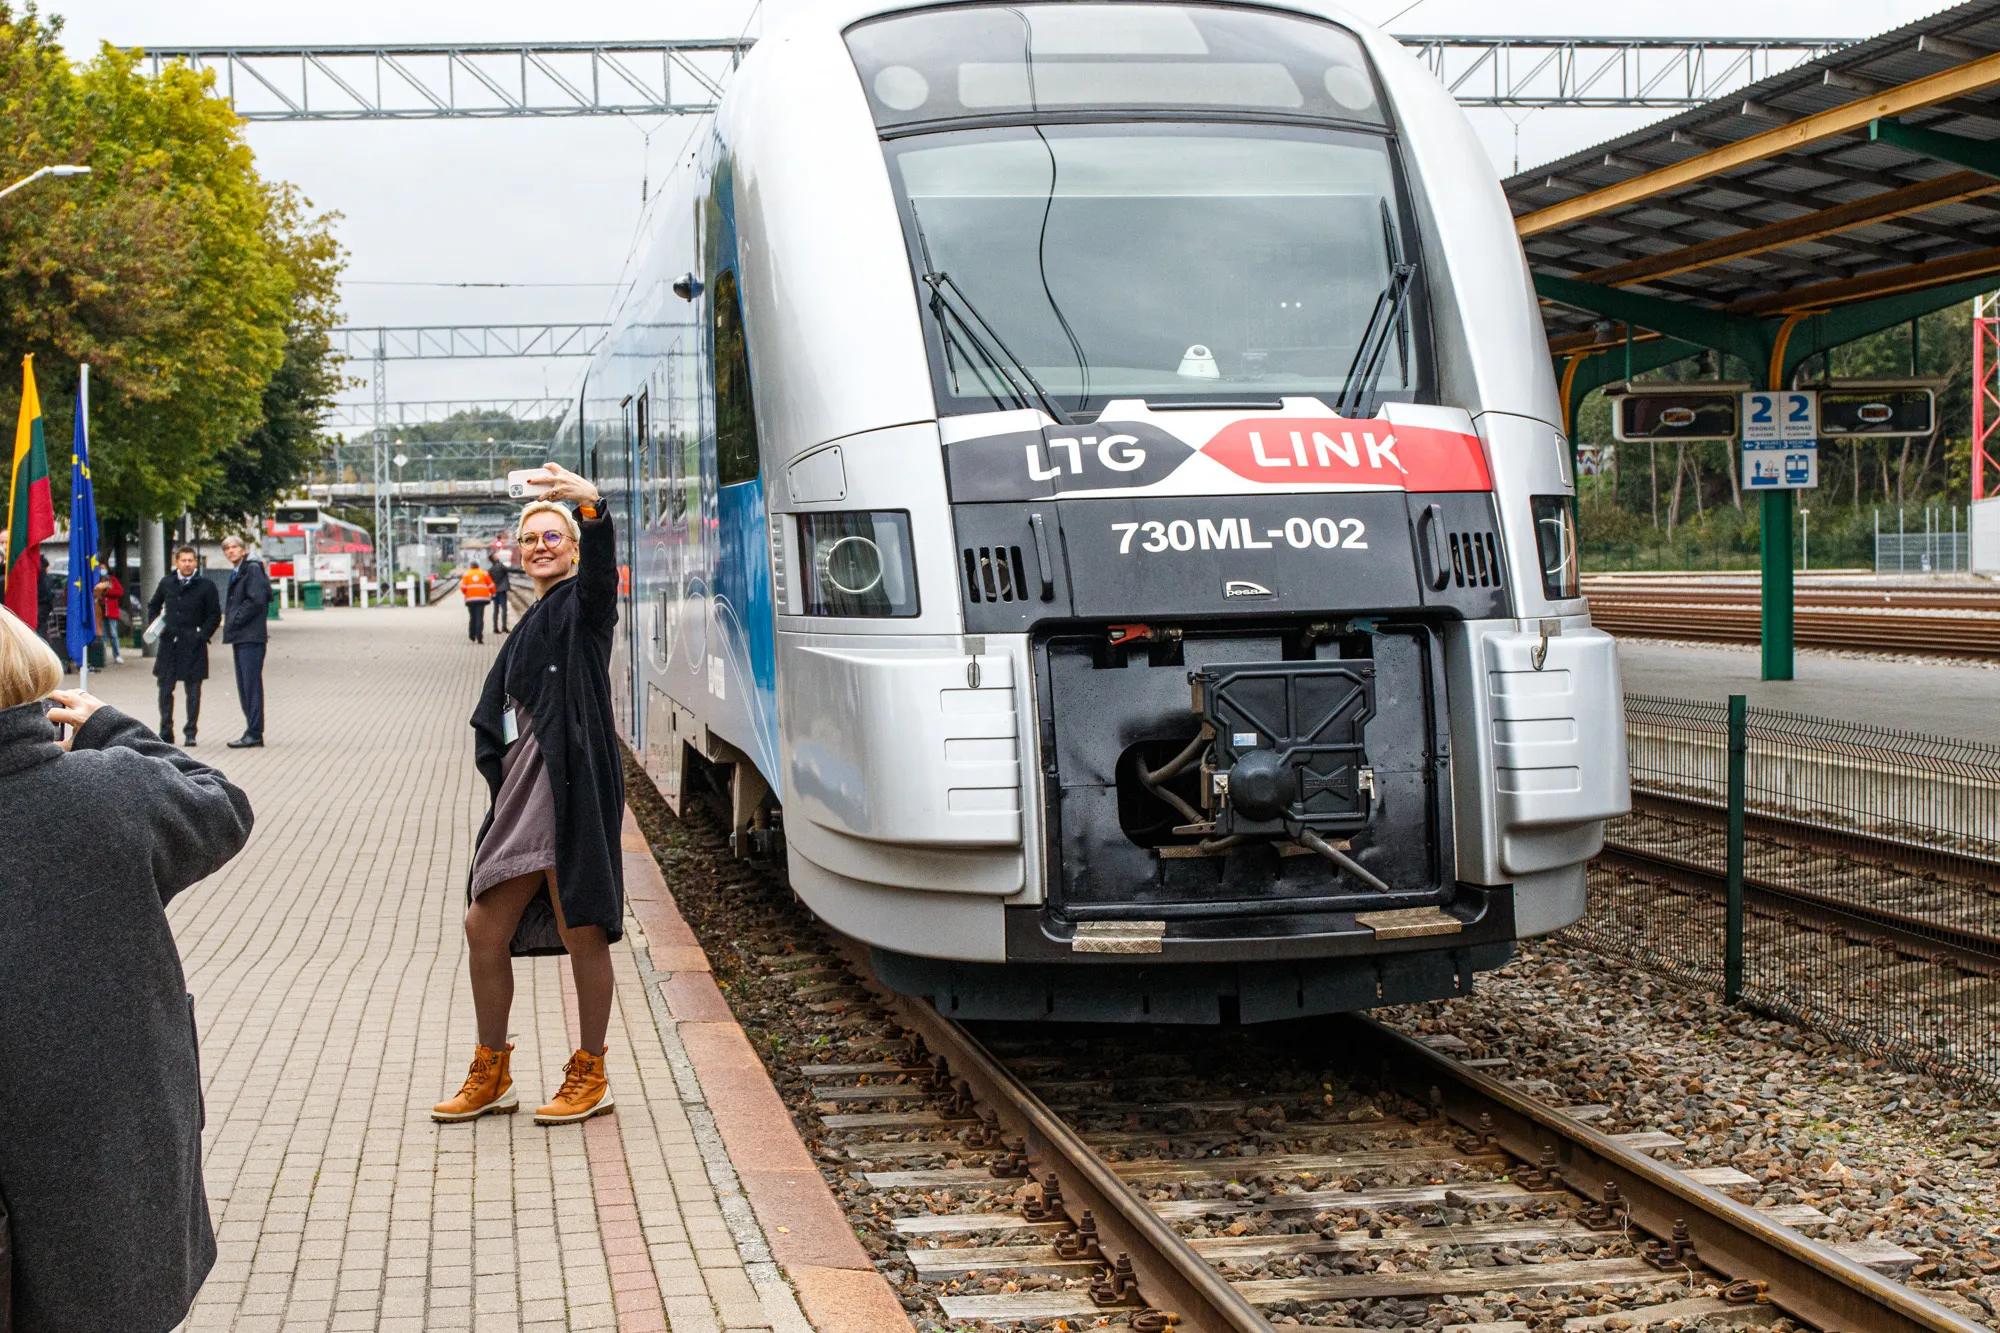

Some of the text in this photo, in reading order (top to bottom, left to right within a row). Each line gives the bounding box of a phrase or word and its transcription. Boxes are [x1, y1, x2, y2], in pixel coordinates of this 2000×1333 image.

[1751, 396, 1772, 423] 2
[1788, 394, 1809, 422] 2
[1025, 434, 1146, 481] LTG
[1248, 431, 1408, 474] LINK
[1754, 441, 1761, 449] 2
[1783, 440, 1789, 449] 3
[1111, 517, 1369, 554] 730ML-002
